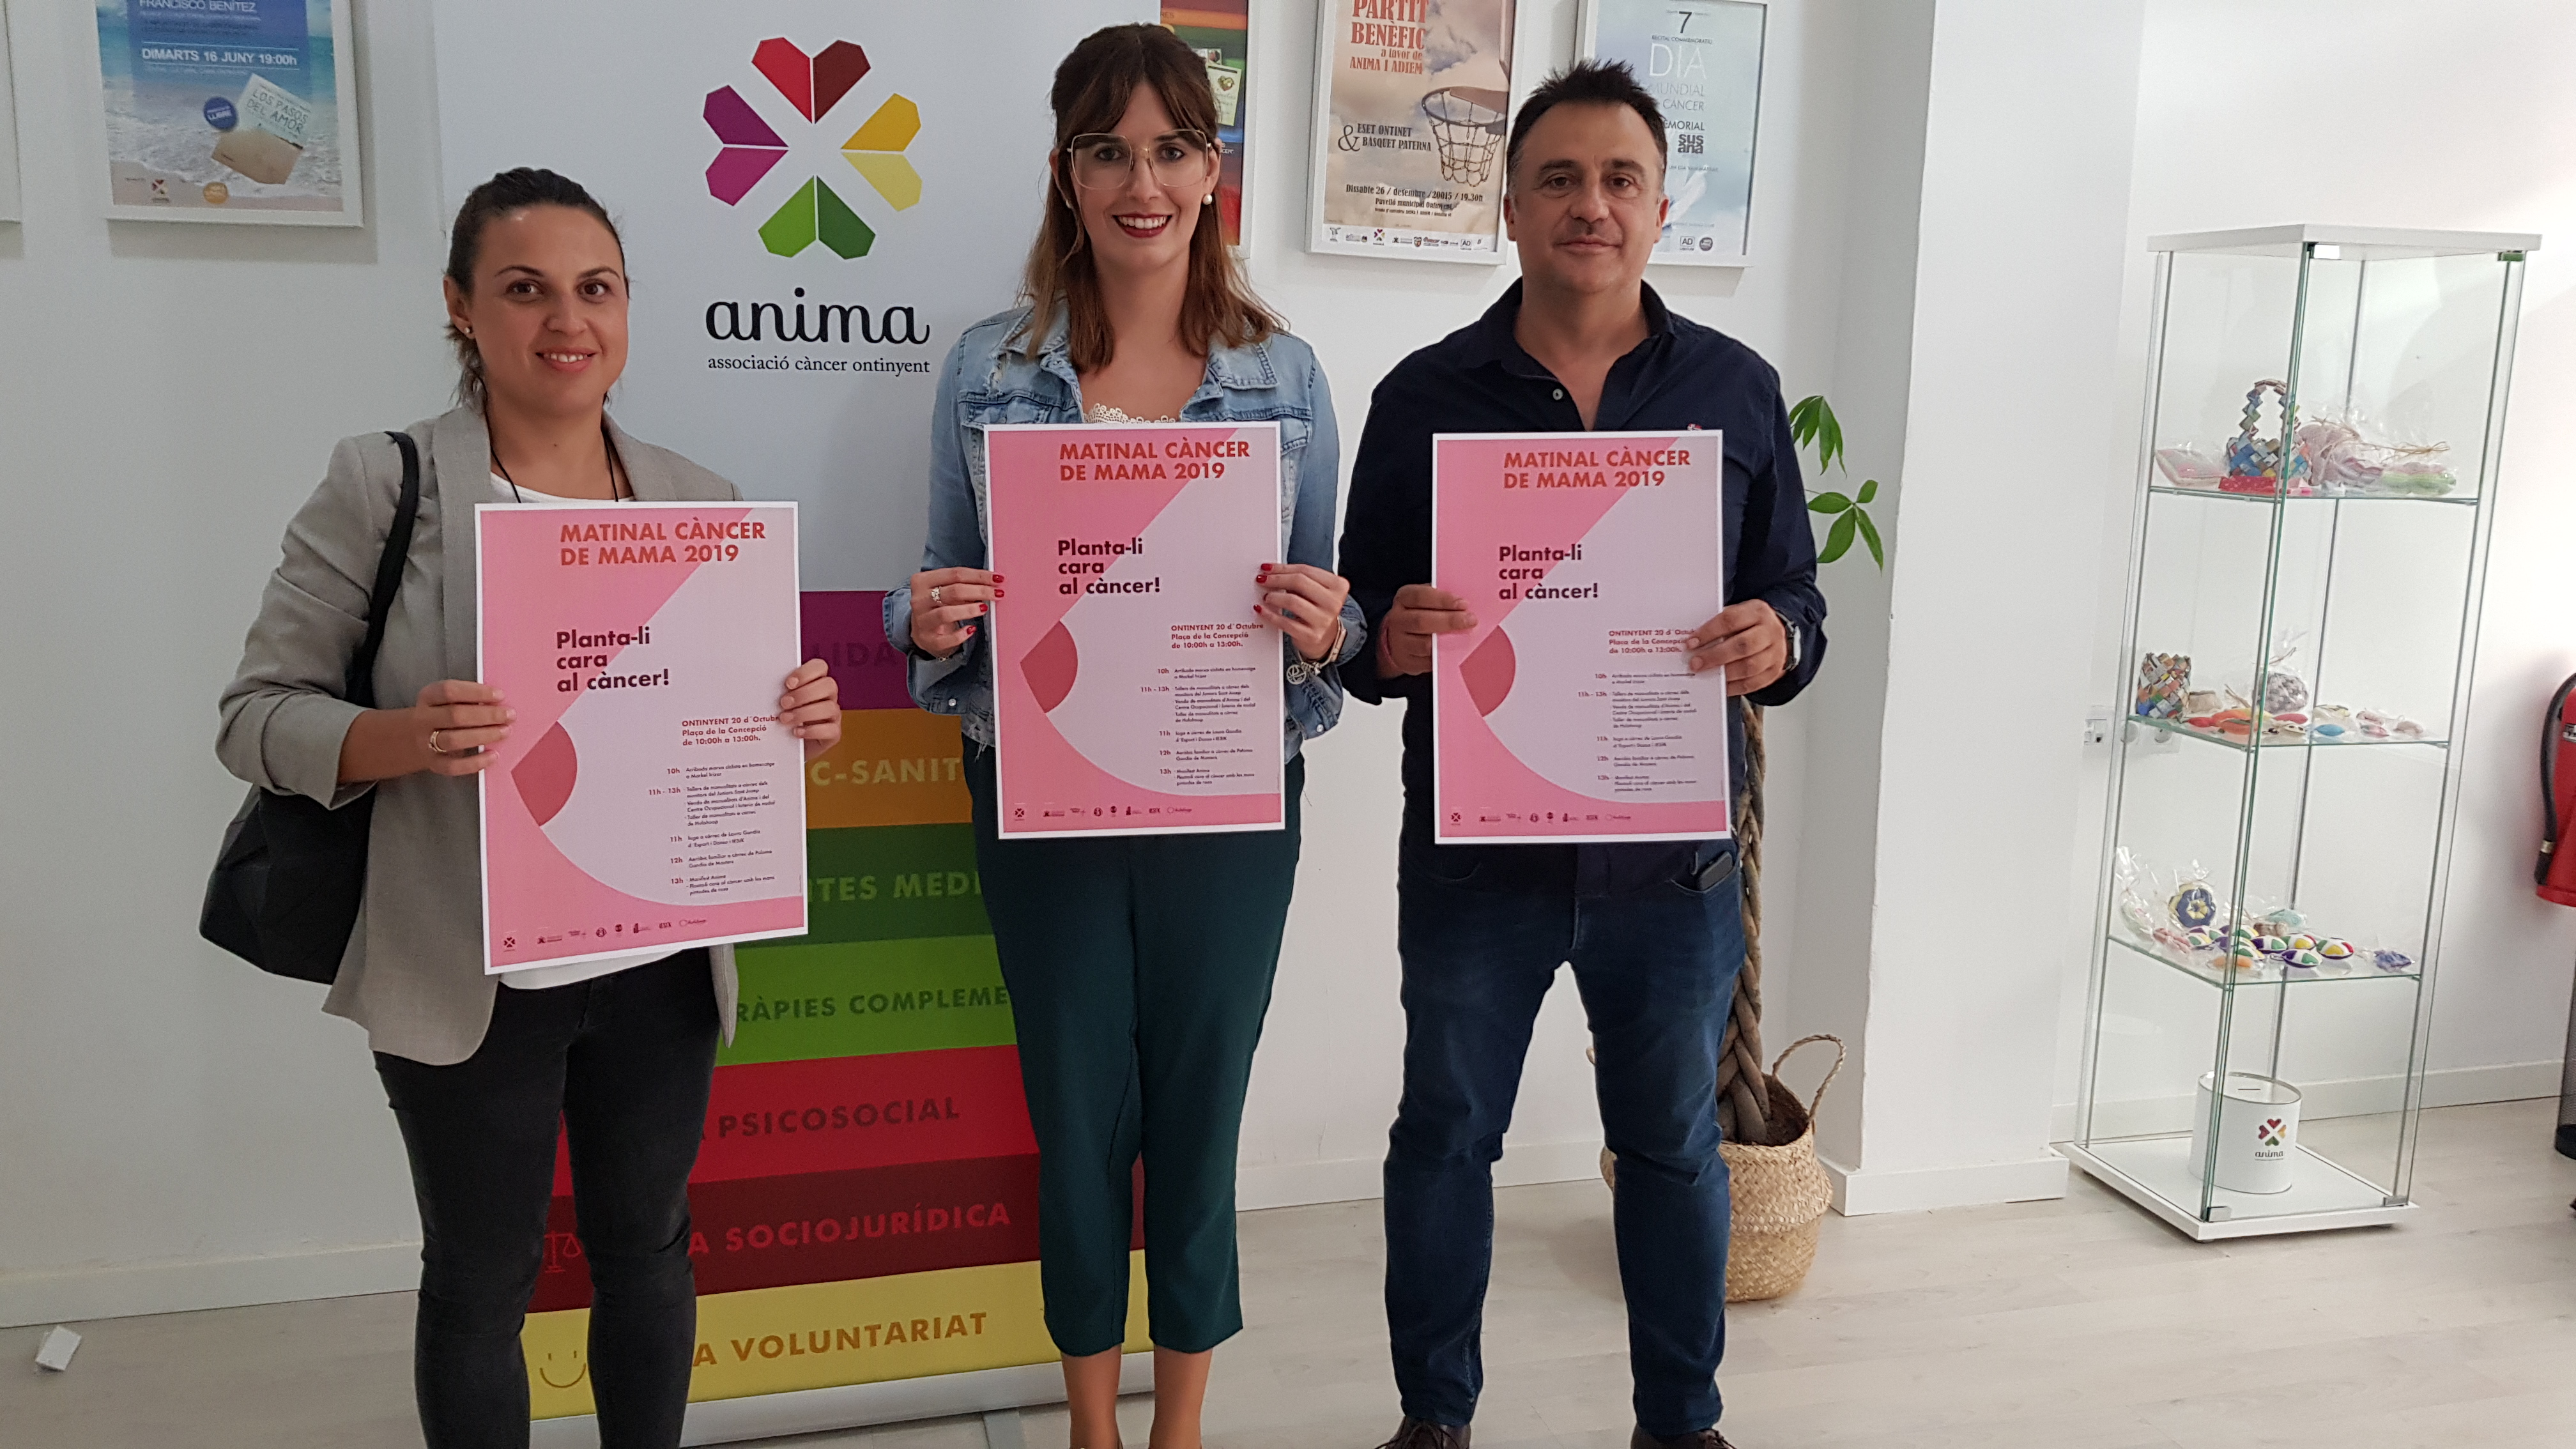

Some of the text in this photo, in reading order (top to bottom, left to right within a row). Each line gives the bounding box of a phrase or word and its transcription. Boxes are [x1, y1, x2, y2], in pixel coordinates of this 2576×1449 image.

[1353, 0, 1429, 23] PARTIT
[1679, 11, 1692, 33] 7
[1351, 20, 1426, 50] BENÈFIC
[142, 48, 297, 65] DIMARTS 16 JUNY 19:00h
[1350, 56, 1422, 75] ANIMA I ADIEM
[1413, 51, 1422, 61] de
[1650, 43, 1707, 79] DIA
[252, 90, 309, 125] LOS PASOS
[270, 111, 303, 134] AMOR
[1357, 123, 1411, 137] ESET ONTINET
[1663, 119, 1705, 131] EMORIAL
[1338, 125, 1361, 151] &
[1399, 140, 1431, 151] PATERNA
[1346, 184, 1374, 194] Dissabte
[1376, 187, 1385, 195] 26
[1376, 197, 1395, 206] Pavelló
[705, 287, 930, 344] anima
[708, 355, 930, 377] associació càncer ontinyent
[1060, 437, 1250, 460] MATINAL CÀNCER
[1503, 446, 1690, 468] MATINAL CÀNCER
[1060, 462, 1225, 481] DE MAMA 2019
[1504, 471, 1666, 489] DE MAMA 2019
[560, 517, 766, 543] MATINAL CÀNCER
[560, 544, 739, 566] DE MAMA 2019
[1058, 537, 1143, 556] Planta-li
[1499, 544, 1582, 562] Planta-li
[1059, 561, 1104, 574] cara
[1499, 567, 1544, 580] cara
[1059, 577, 1160, 595] al càncer!
[1499, 583, 1598, 600] al càncer!
[556, 625, 650, 649] Planta-li
[556, 652, 608, 670] cara
[556, 668, 670, 693] al càncer!
[682, 717, 730, 727] ONTINYENT
[728, 724, 767, 734] Concepció
[696, 737, 723, 745] 10:00h
[849, 986, 1008, 1014] COMPLEME
[718, 1096, 960, 1138] PSICOSOCIAL
[2255, 1149, 2283, 1158] anima
[725, 1202, 1011, 1252] SOCIOJURÍDICA
[693, 1312, 987, 1367] A VOLUNTARIAT
